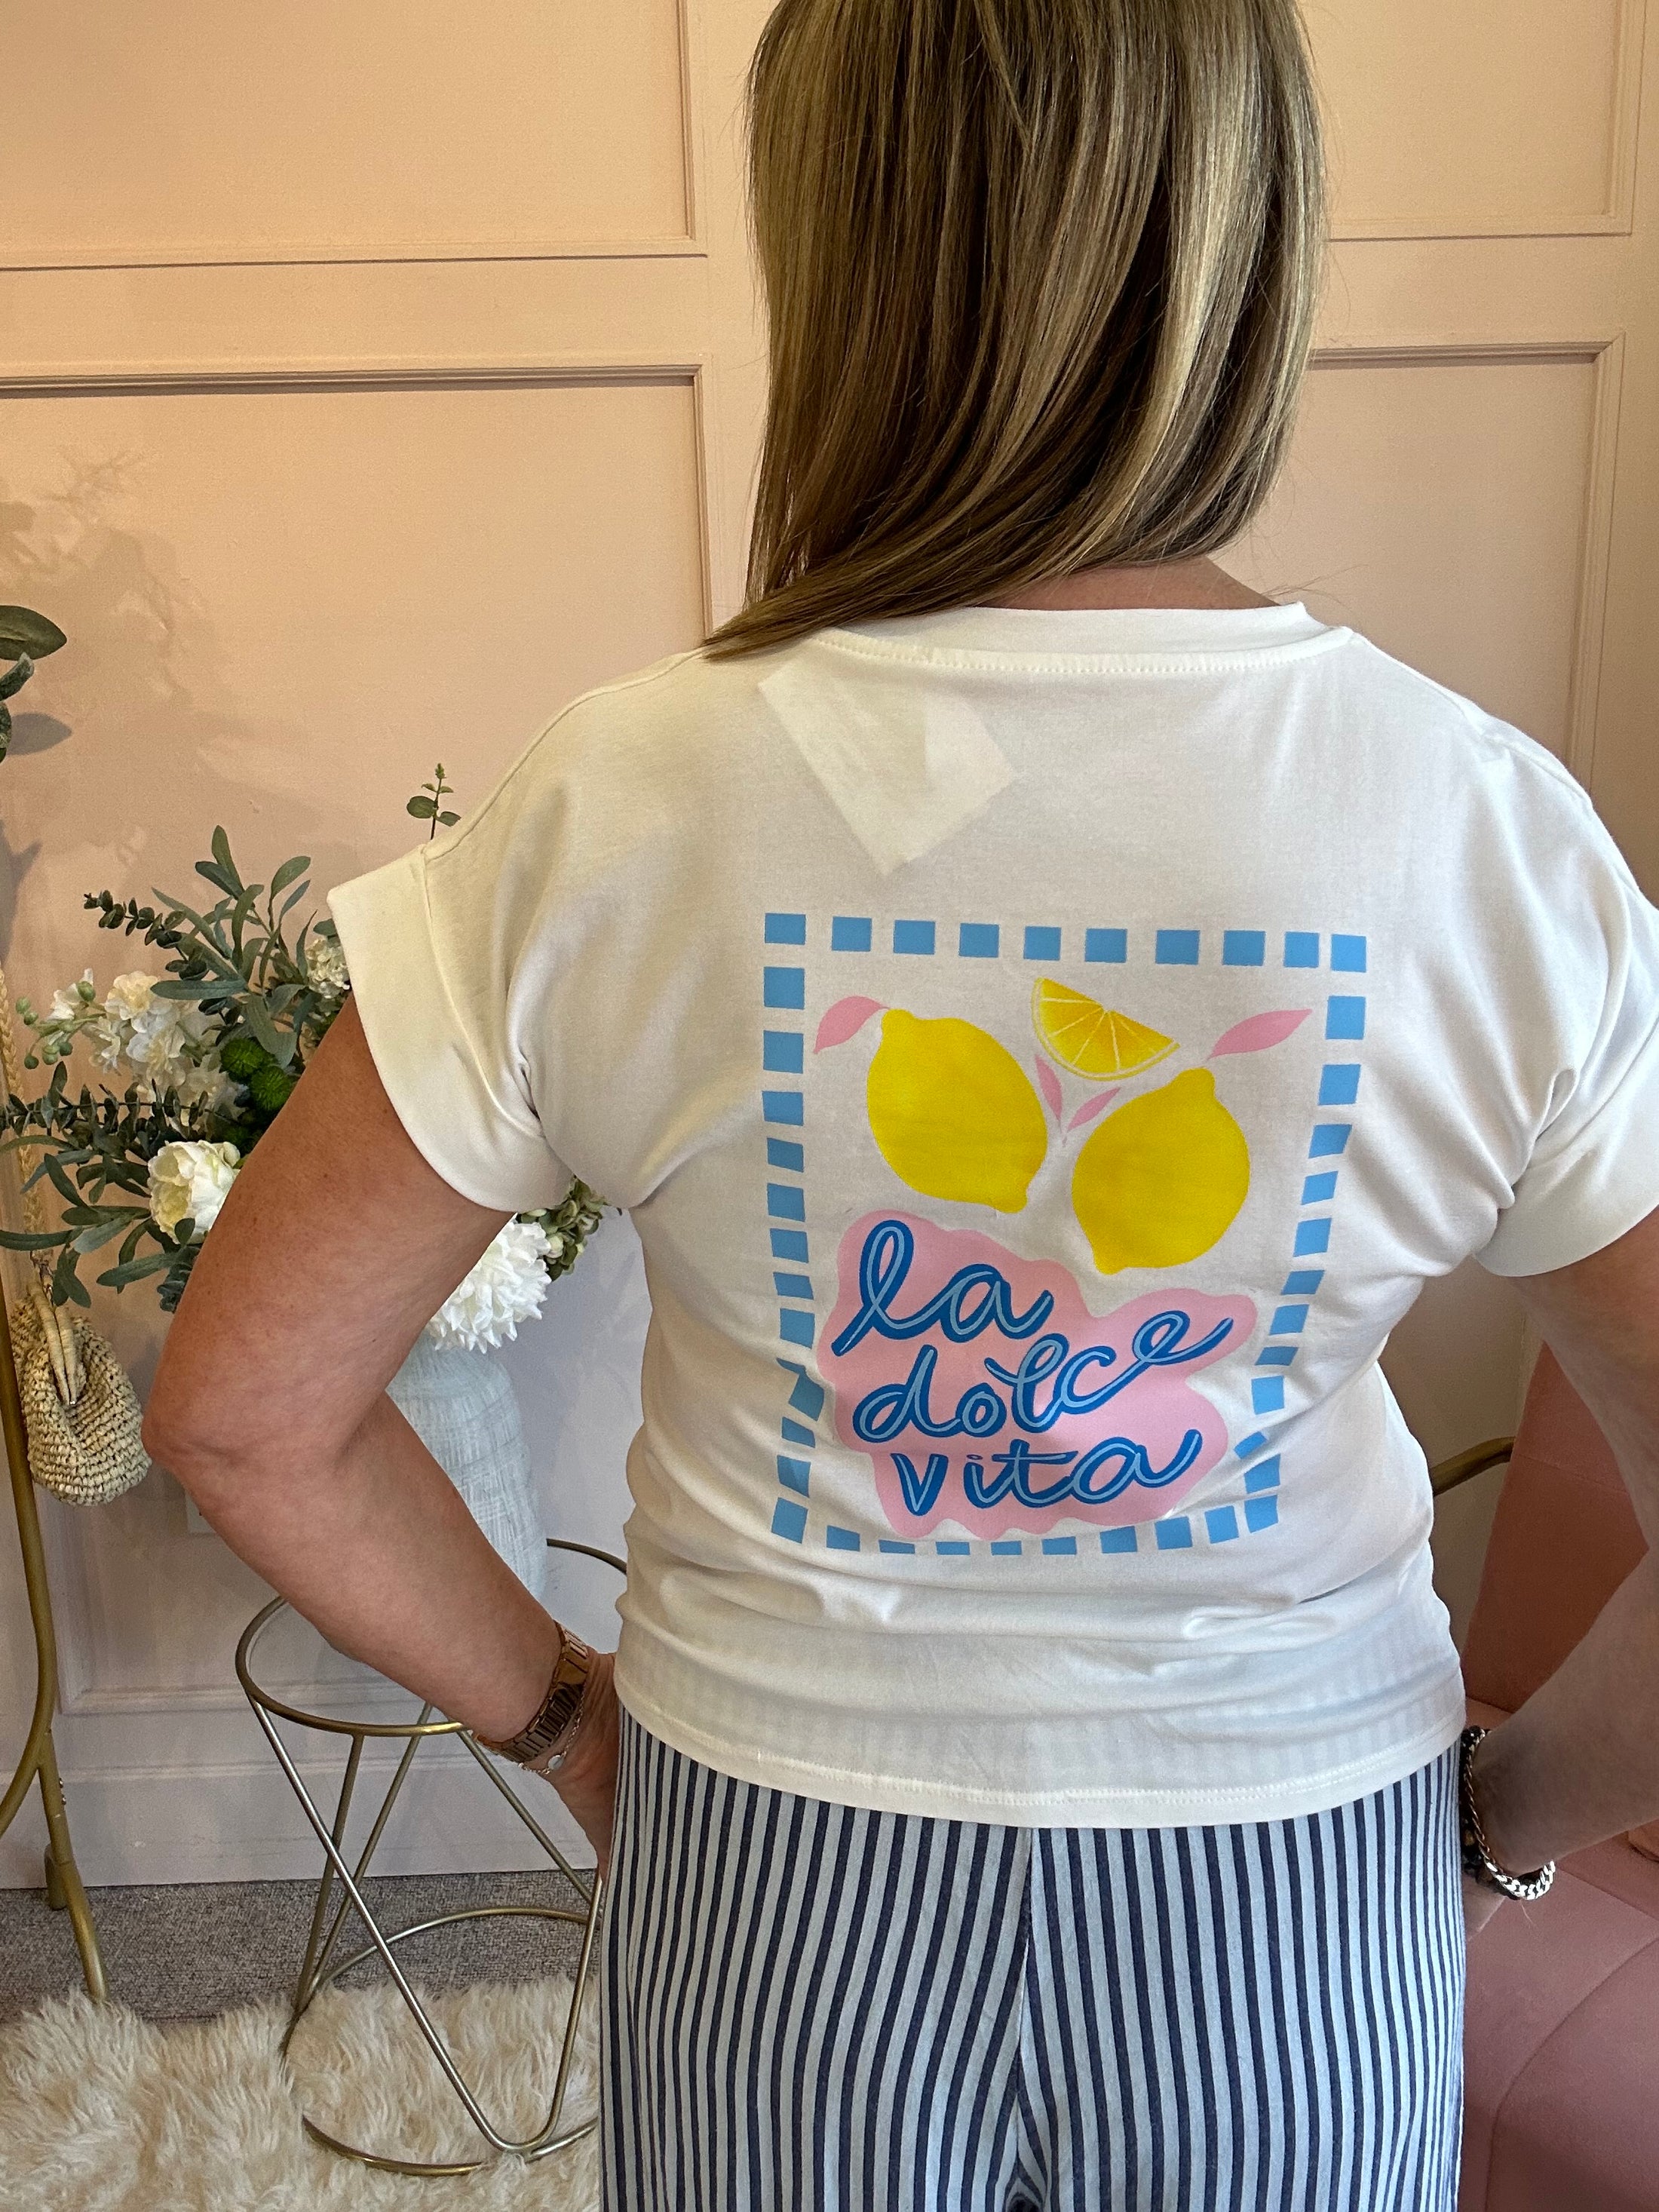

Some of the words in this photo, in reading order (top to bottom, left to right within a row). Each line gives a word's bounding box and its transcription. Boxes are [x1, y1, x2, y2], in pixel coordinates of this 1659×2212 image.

[832, 1220, 1053, 1357] la
[852, 1310, 1233, 1443] dolce
[891, 1429, 1203, 1516] vita
